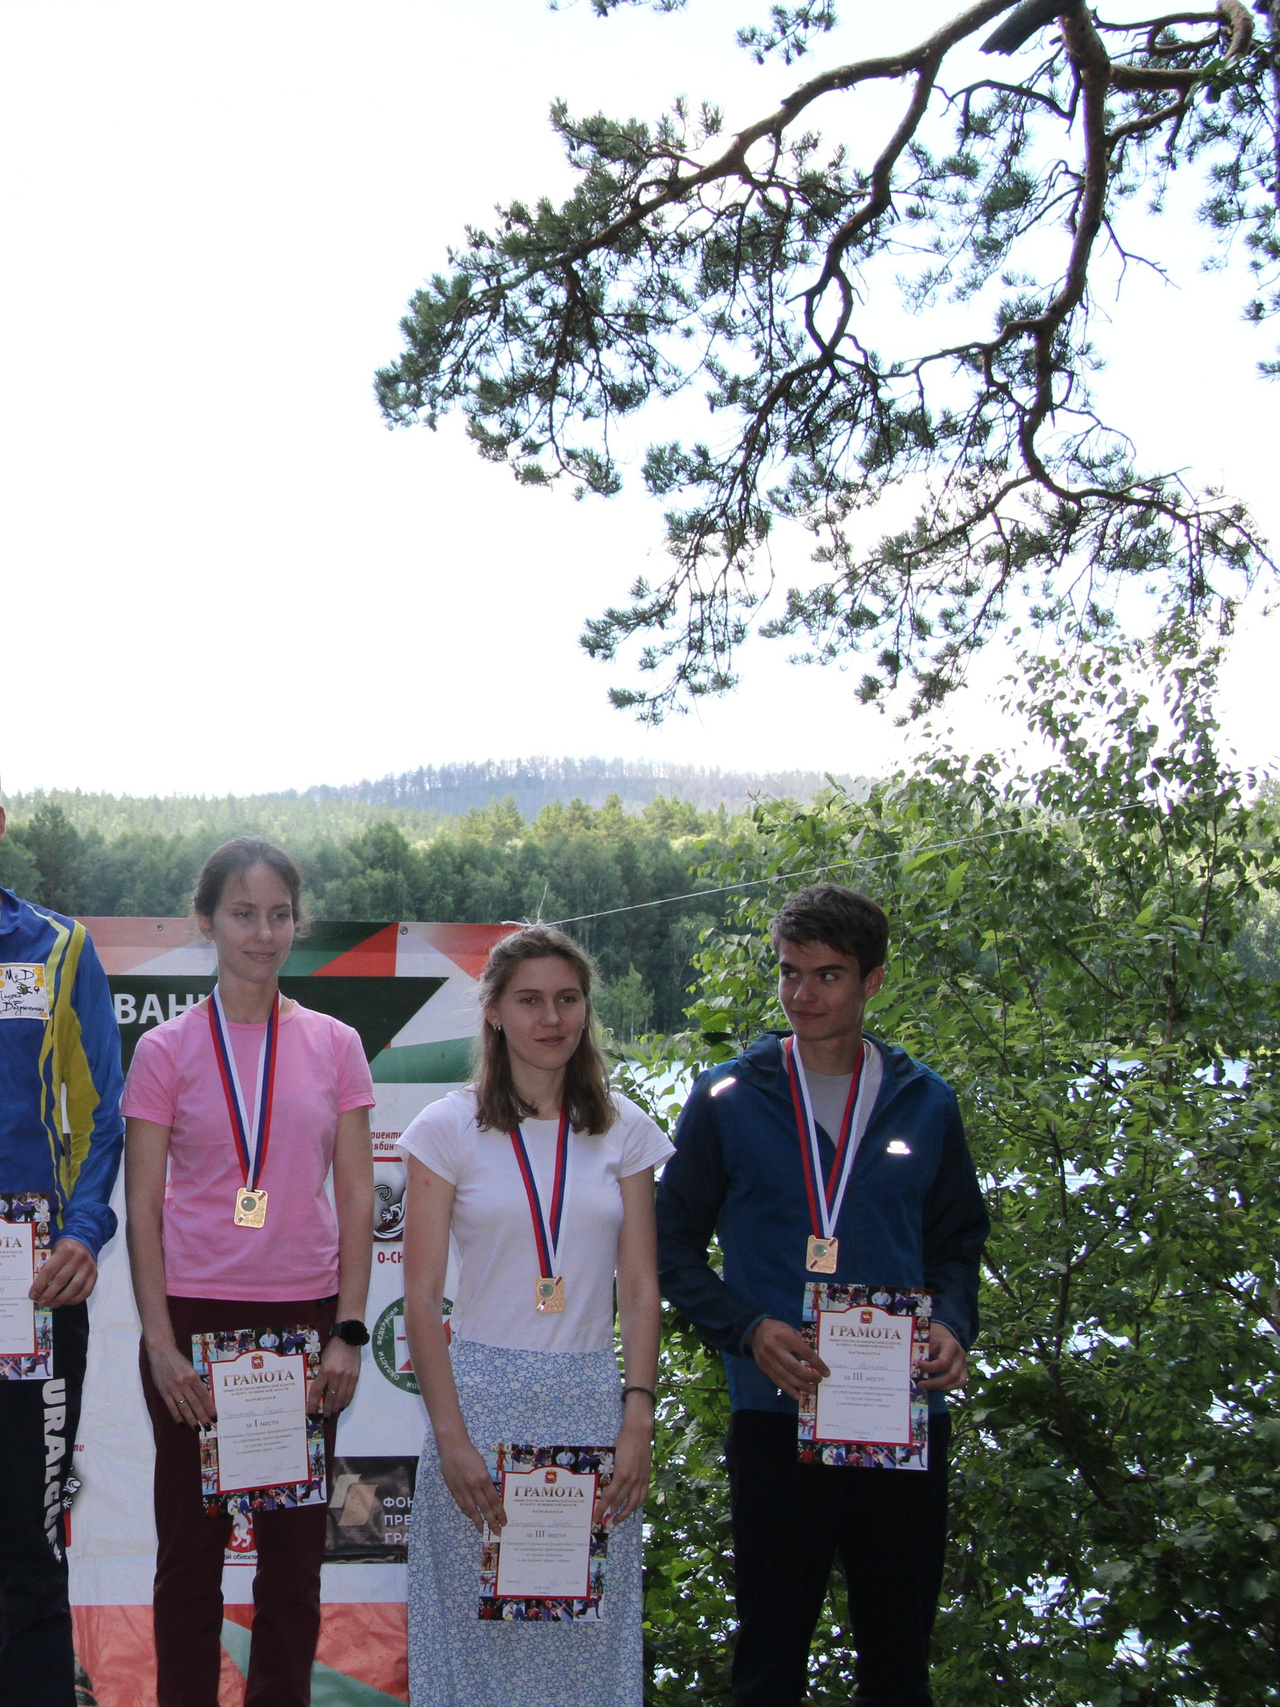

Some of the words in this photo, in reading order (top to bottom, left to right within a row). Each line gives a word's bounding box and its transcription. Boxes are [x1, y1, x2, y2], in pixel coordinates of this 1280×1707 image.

[829, 1324, 902, 1340] ГРАМОТА
[223, 1370, 295, 1387] ГРАМОТА
[852, 1372, 863, 1380] III
[260, 1419, 280, 1427] место
[513, 1486, 585, 1498] ГРАМОТА
[535, 1530, 545, 1538] III
